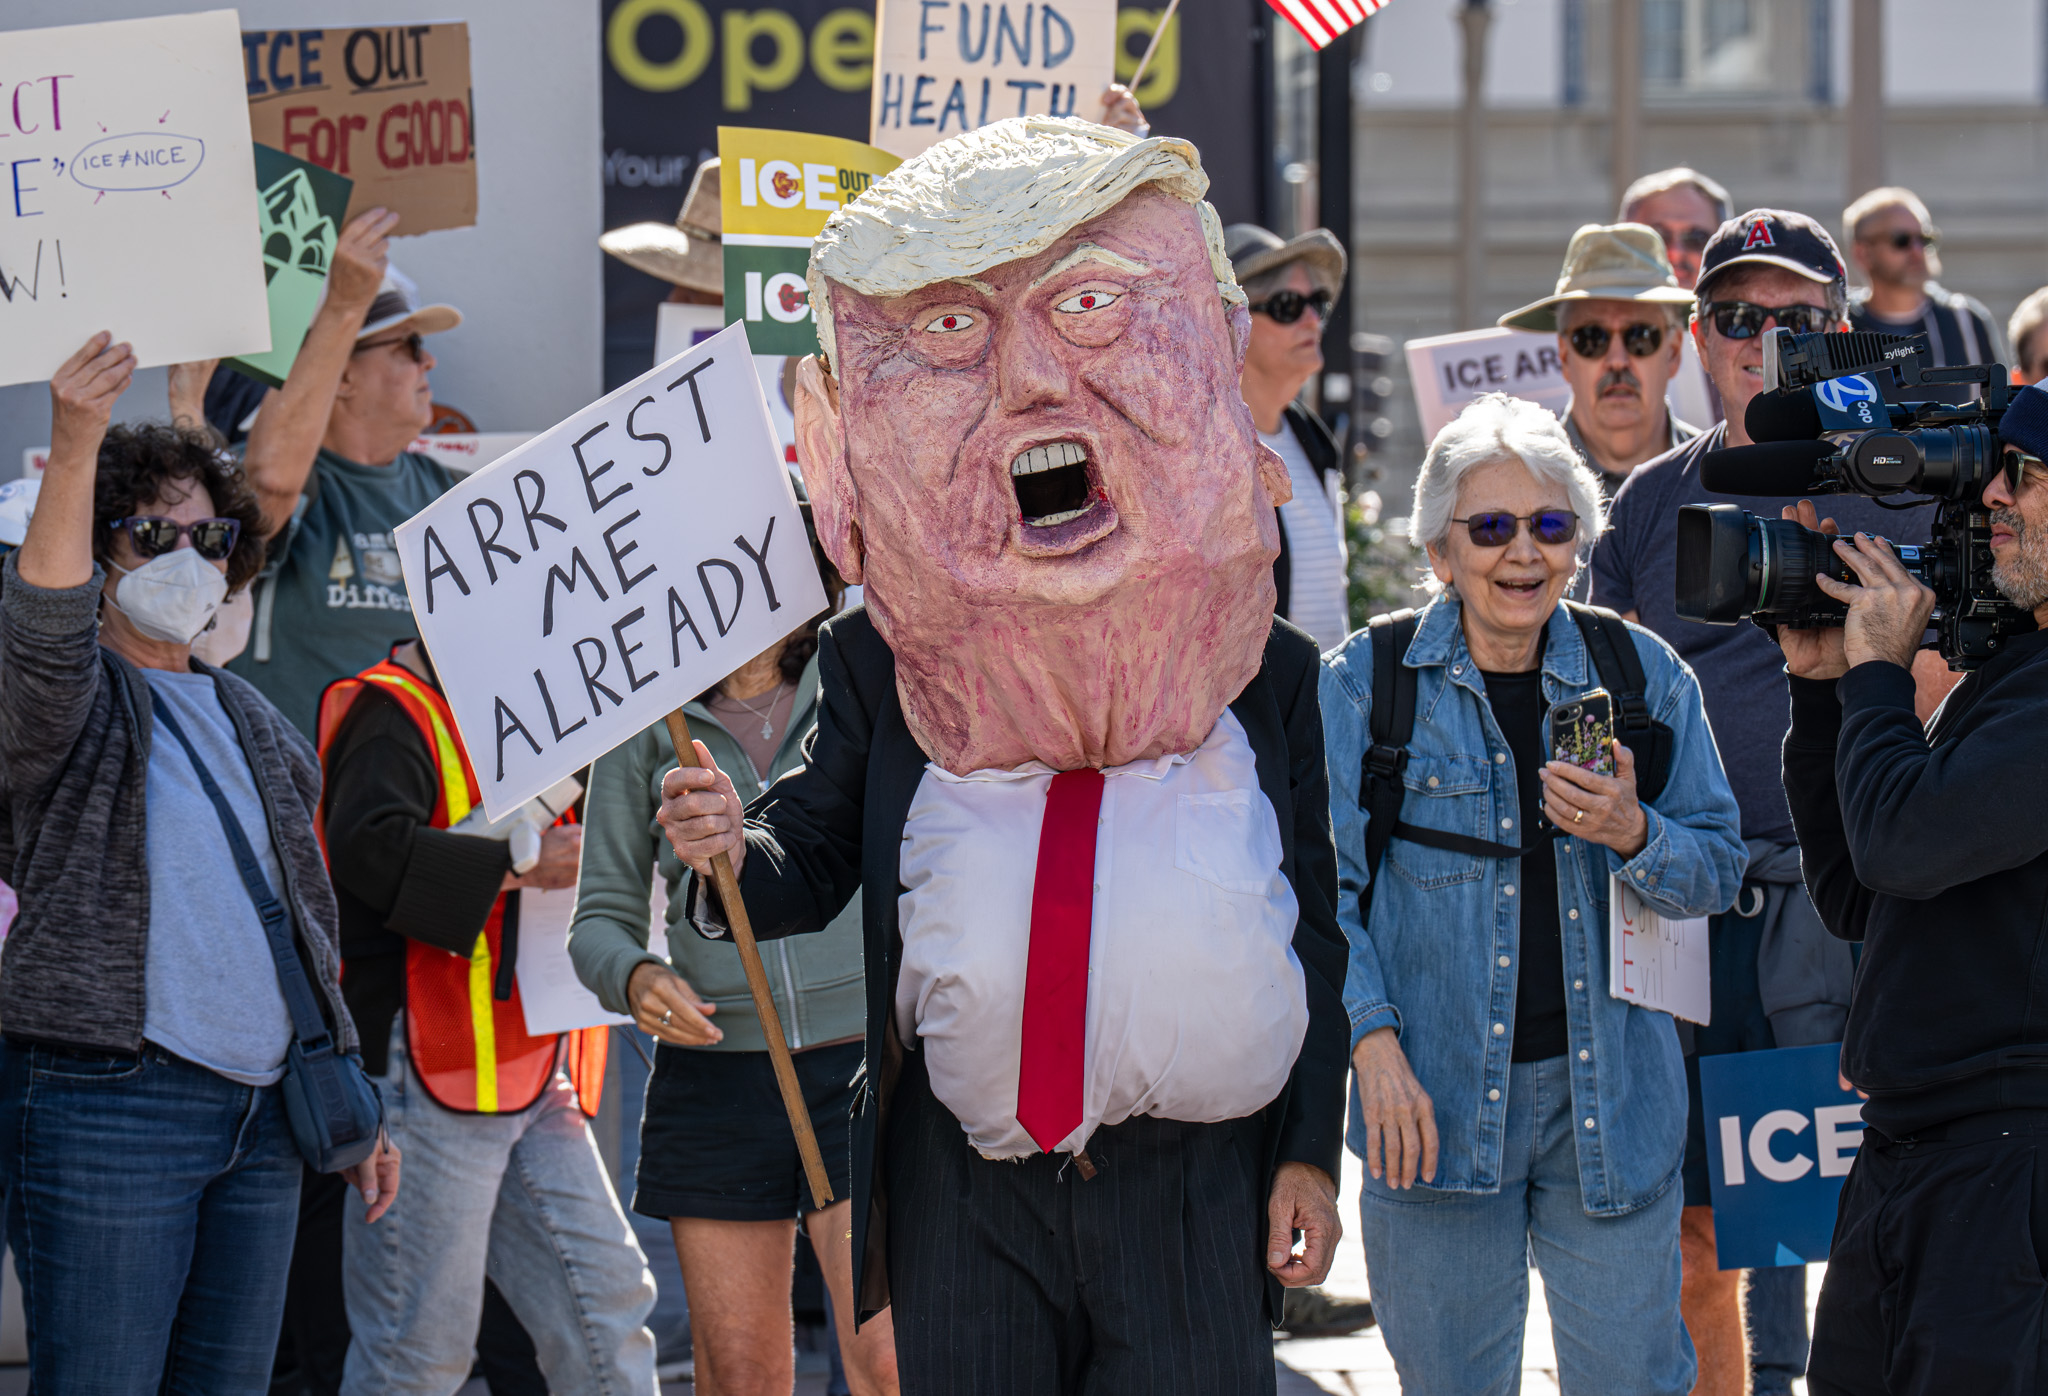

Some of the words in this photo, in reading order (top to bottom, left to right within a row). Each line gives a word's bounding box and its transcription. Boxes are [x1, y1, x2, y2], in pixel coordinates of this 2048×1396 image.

[243, 30, 325, 95] ICE
[919, 0, 1075, 69] FUND
[0, 74, 75, 137] CT
[376, 97, 475, 170] GOOD!
[739, 158, 840, 211] ICE
[839, 168, 870, 192] OUT
[1741, 213, 1776, 251] A
[745, 272, 818, 324] IC
[1443, 354, 1507, 392] ICE
[1884, 345, 1916, 361] zylight
[1857, 400, 1874, 424] abc
[424, 357, 714, 614] ARREST
[1872, 456, 1887, 466] HD
[543, 509, 657, 637] ME
[495, 516, 781, 781] ALREADY
[1719, 1102, 1864, 1186] ICE
